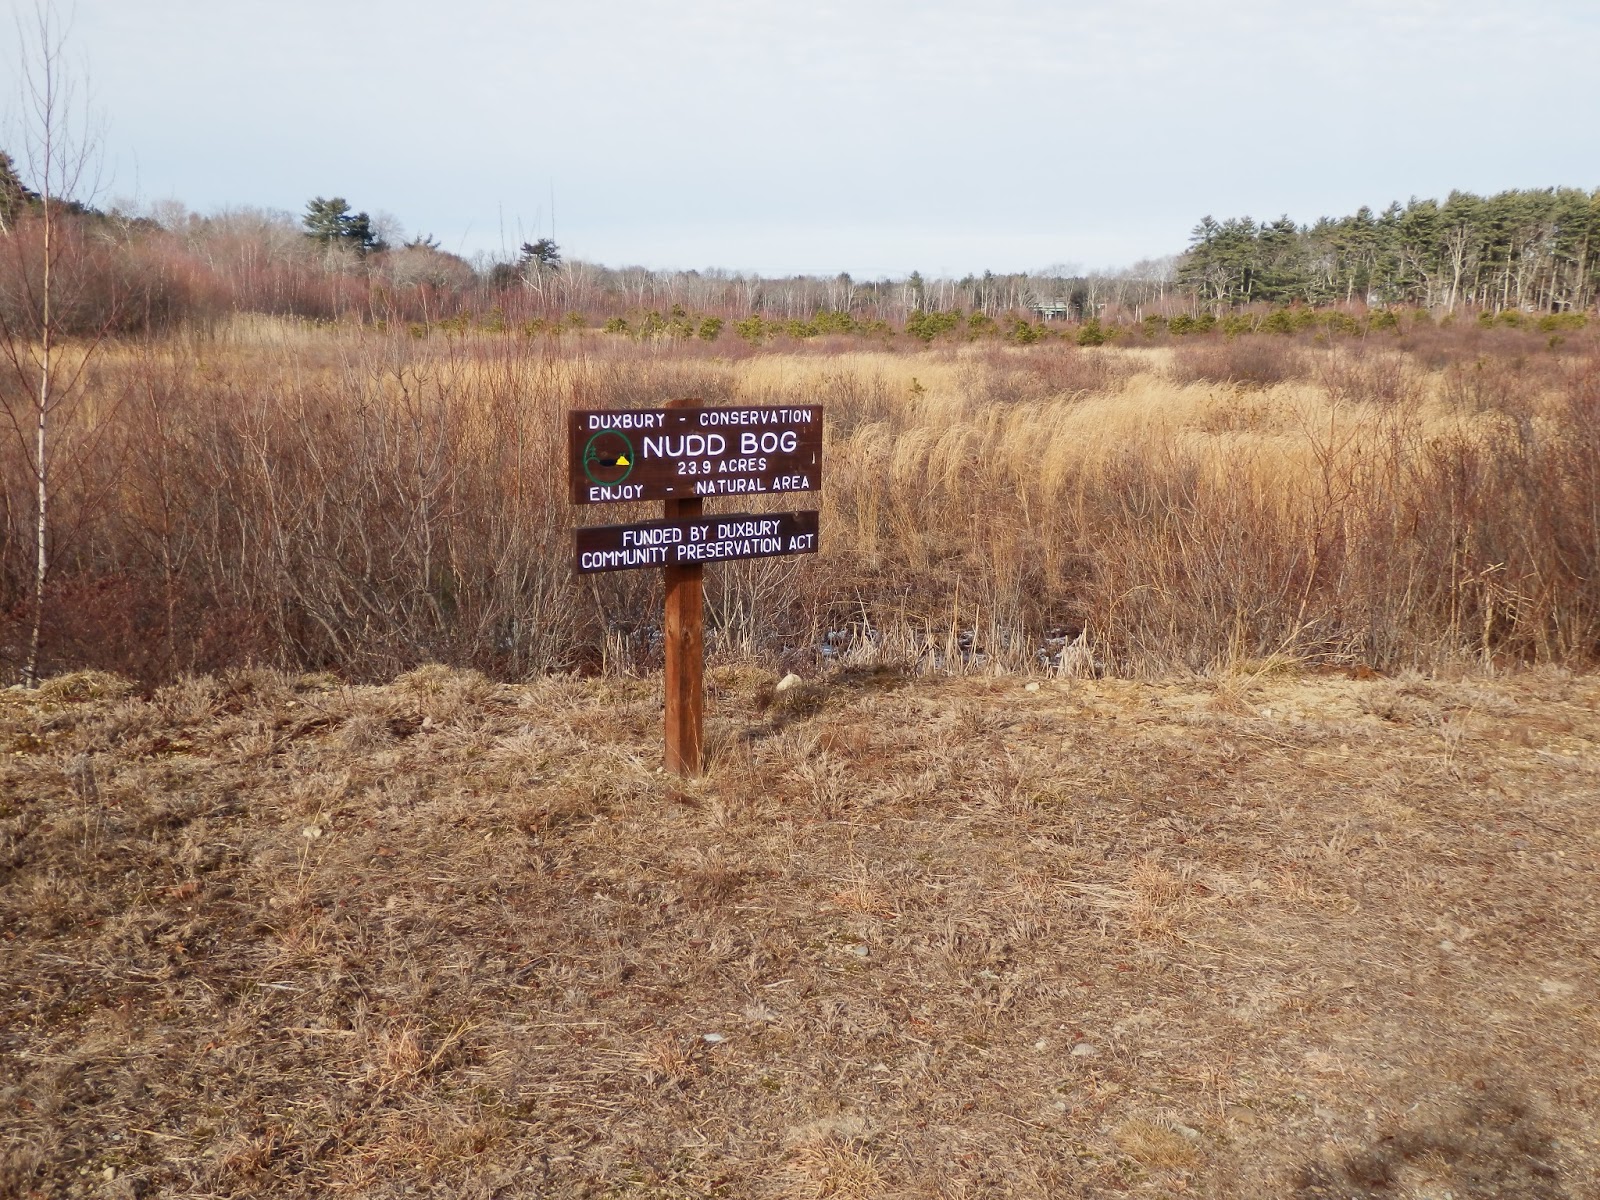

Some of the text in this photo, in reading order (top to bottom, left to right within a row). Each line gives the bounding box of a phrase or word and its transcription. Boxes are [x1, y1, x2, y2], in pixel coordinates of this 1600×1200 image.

[589, 414, 665, 429] DUXBURY
[700, 410, 812, 426] CONSERVATION
[643, 431, 797, 458] NUDD BOG
[678, 458, 767, 475] 23.9 ACRES
[590, 484, 644, 501] ENJOY
[696, 479, 766, 495] NATURAL
[773, 476, 810, 490] AREA
[623, 520, 781, 546] FUNDED BY DUXBURY
[582, 534, 814, 569] COMMUNITY PRESERVATION ACT
